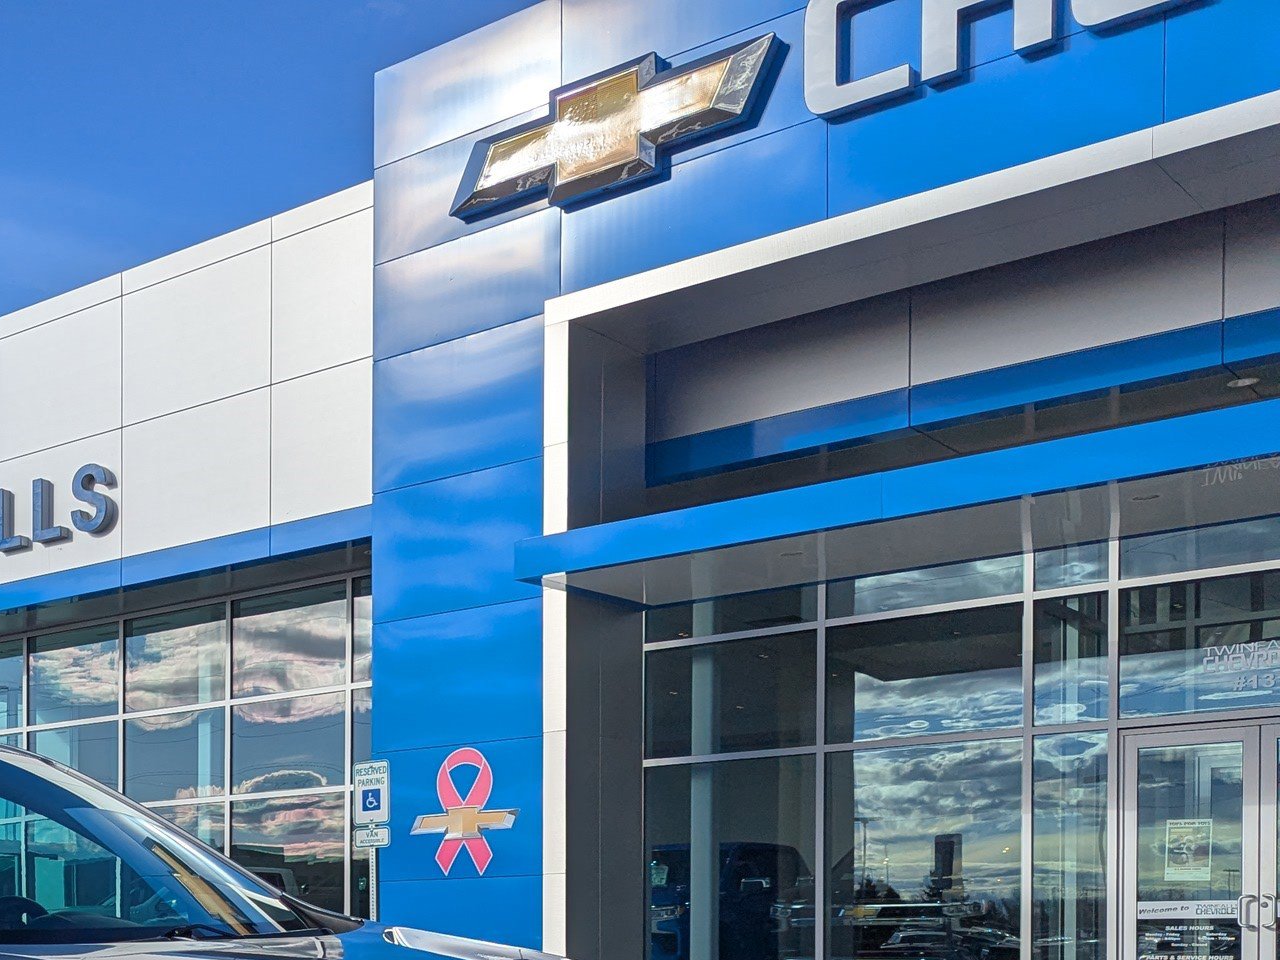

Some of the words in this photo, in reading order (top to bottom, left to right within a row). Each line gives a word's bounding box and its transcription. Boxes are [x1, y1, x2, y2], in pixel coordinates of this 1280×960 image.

[356, 766, 386, 776] RESERVED
[358, 777, 385, 787] PARKING
[1139, 907, 1177, 915] Welcome
